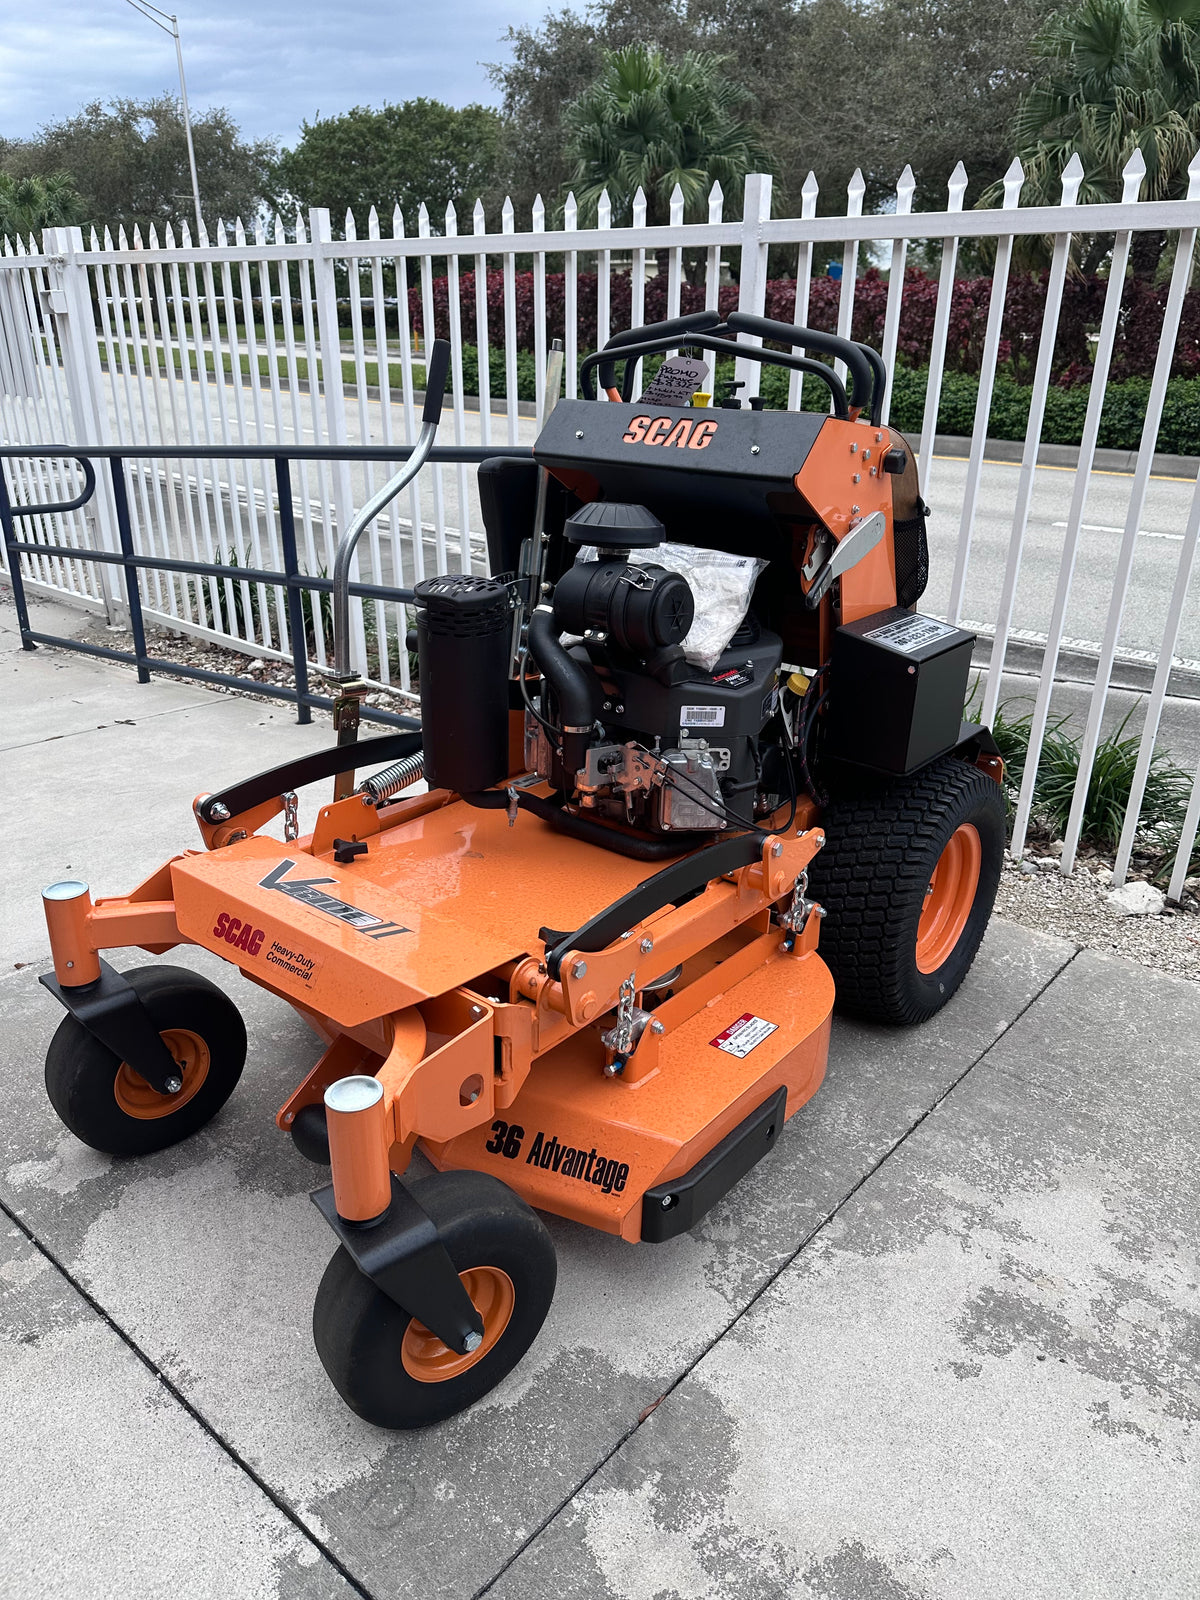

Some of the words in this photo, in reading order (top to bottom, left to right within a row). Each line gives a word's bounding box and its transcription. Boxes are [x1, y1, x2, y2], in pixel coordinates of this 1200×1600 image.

[660, 365, 698, 378] PROMO
[622, 414, 719, 449] SCAG
[213, 912, 266, 957] SCAG
[266, 952, 313, 981] Commercial
[270, 941, 315, 971] Heavy-Duty
[726, 1018, 748, 1035] DANGER
[485, 1119, 525, 1160] 36
[525, 1131, 630, 1194] Advantage
